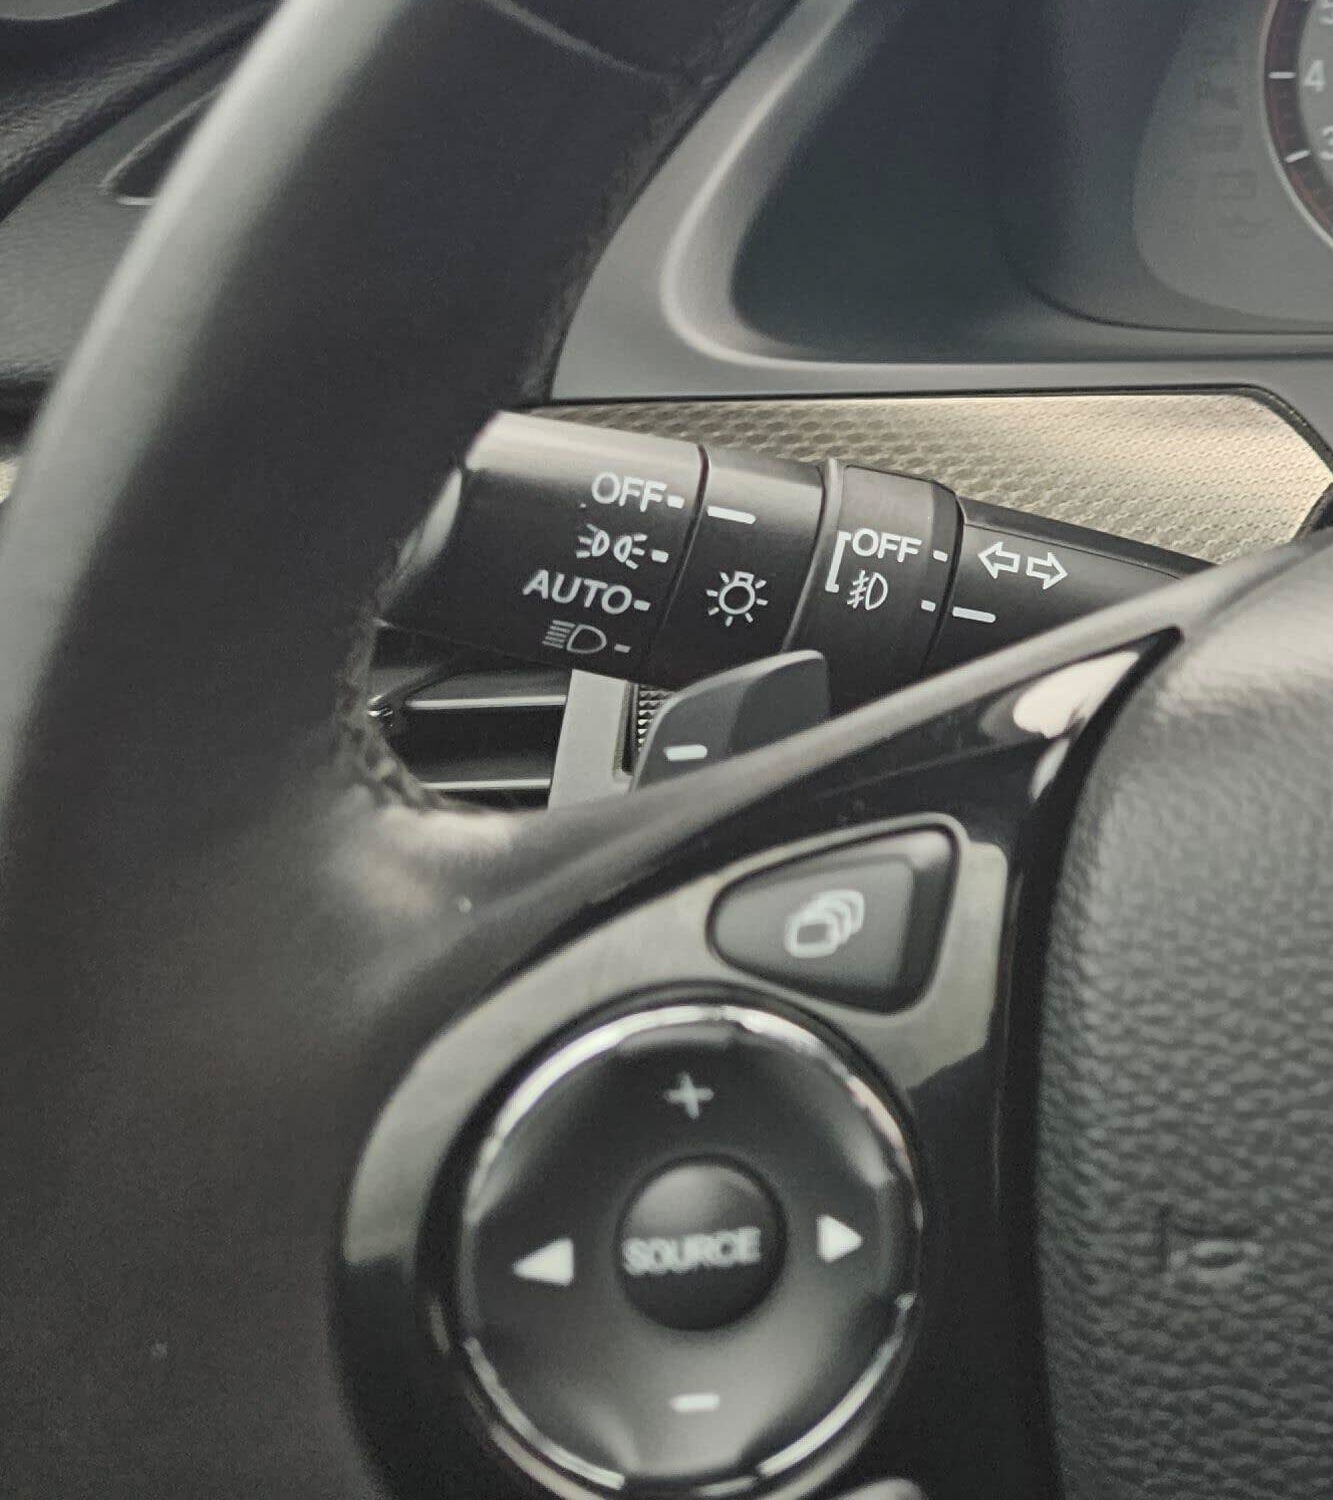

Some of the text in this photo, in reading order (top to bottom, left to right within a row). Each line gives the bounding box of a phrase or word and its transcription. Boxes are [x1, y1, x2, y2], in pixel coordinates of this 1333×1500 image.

[1304, 60, 1326, 92] 4
[592, 471, 667, 512] OFF
[852, 527, 922, 563] OFF
[522, 568, 633, 615] AUTO
[623, 1226, 762, 1276] SOURCE
